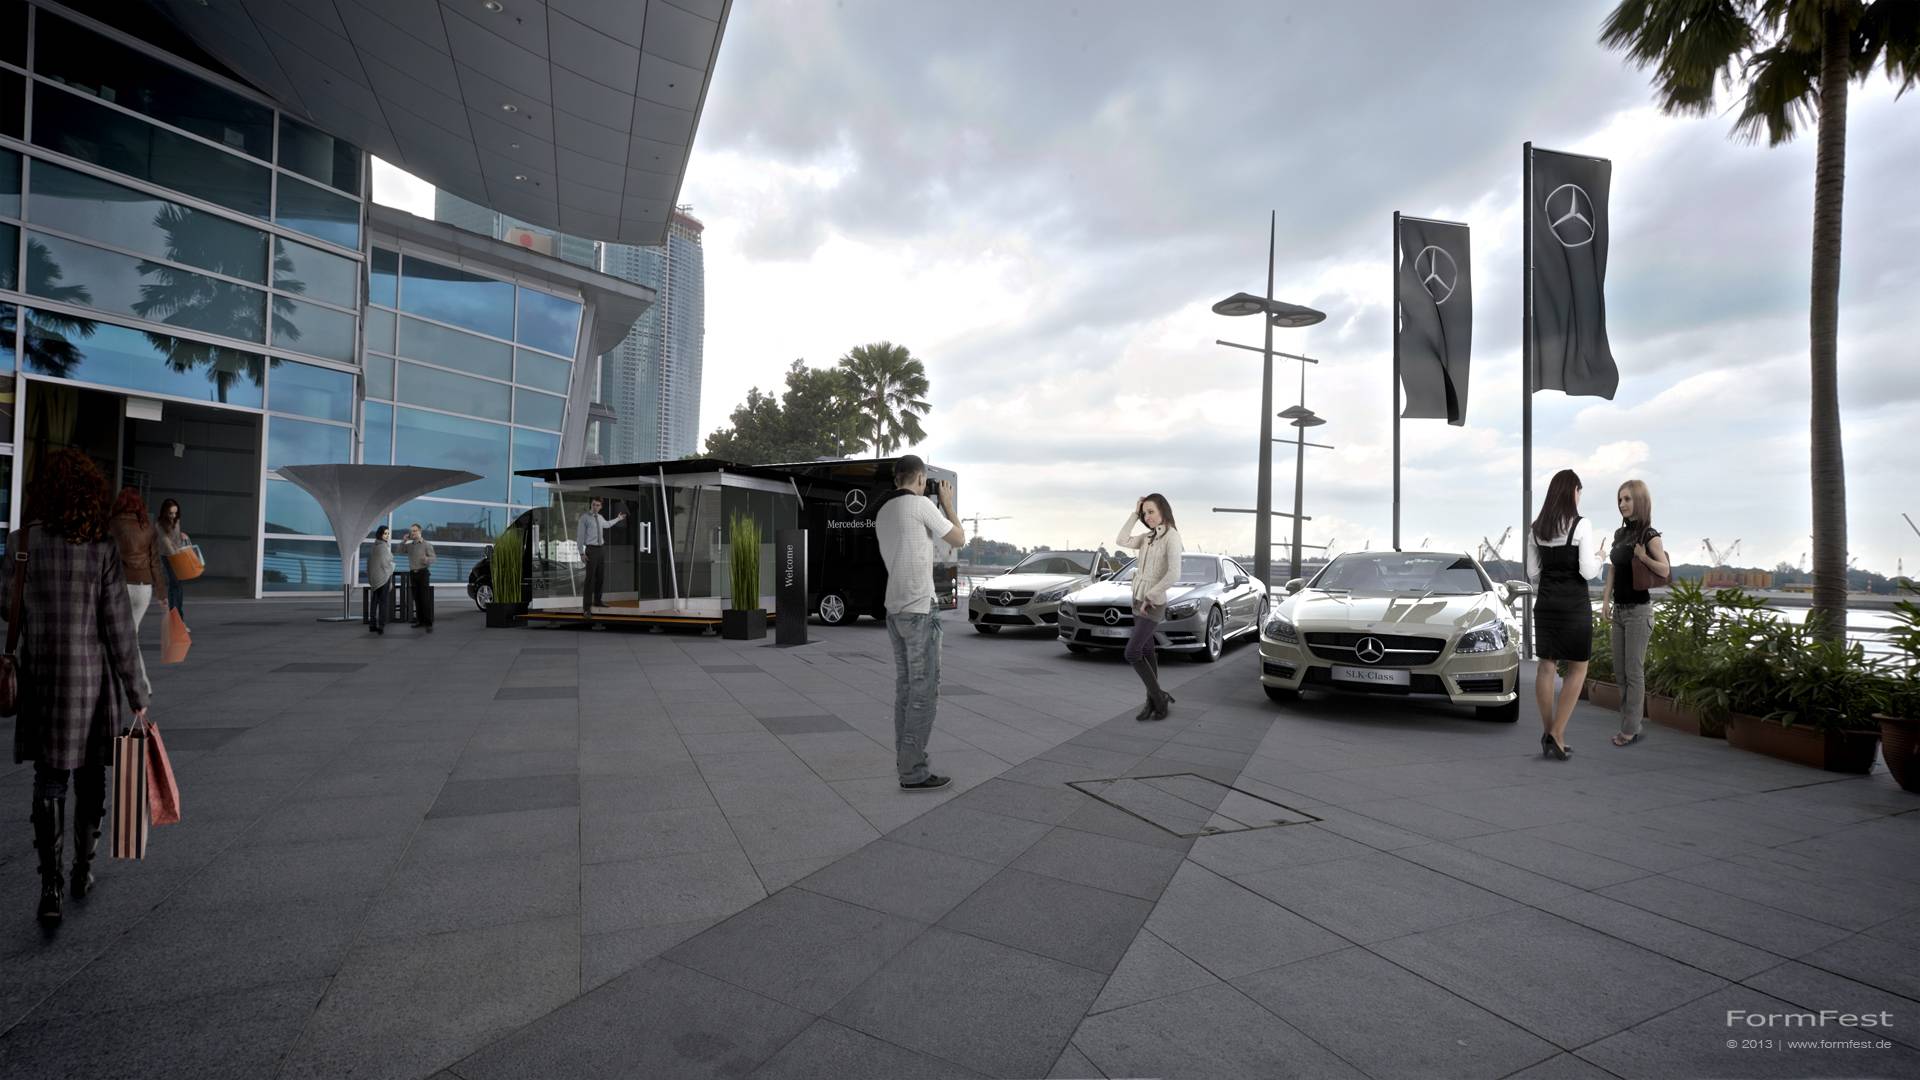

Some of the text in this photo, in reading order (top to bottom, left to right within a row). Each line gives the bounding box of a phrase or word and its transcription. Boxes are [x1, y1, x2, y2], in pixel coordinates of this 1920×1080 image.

[827, 519, 876, 529] Mercedes-Be
[785, 544, 794, 587] Welcome
[1345, 669, 1394, 681] SLK-Class
